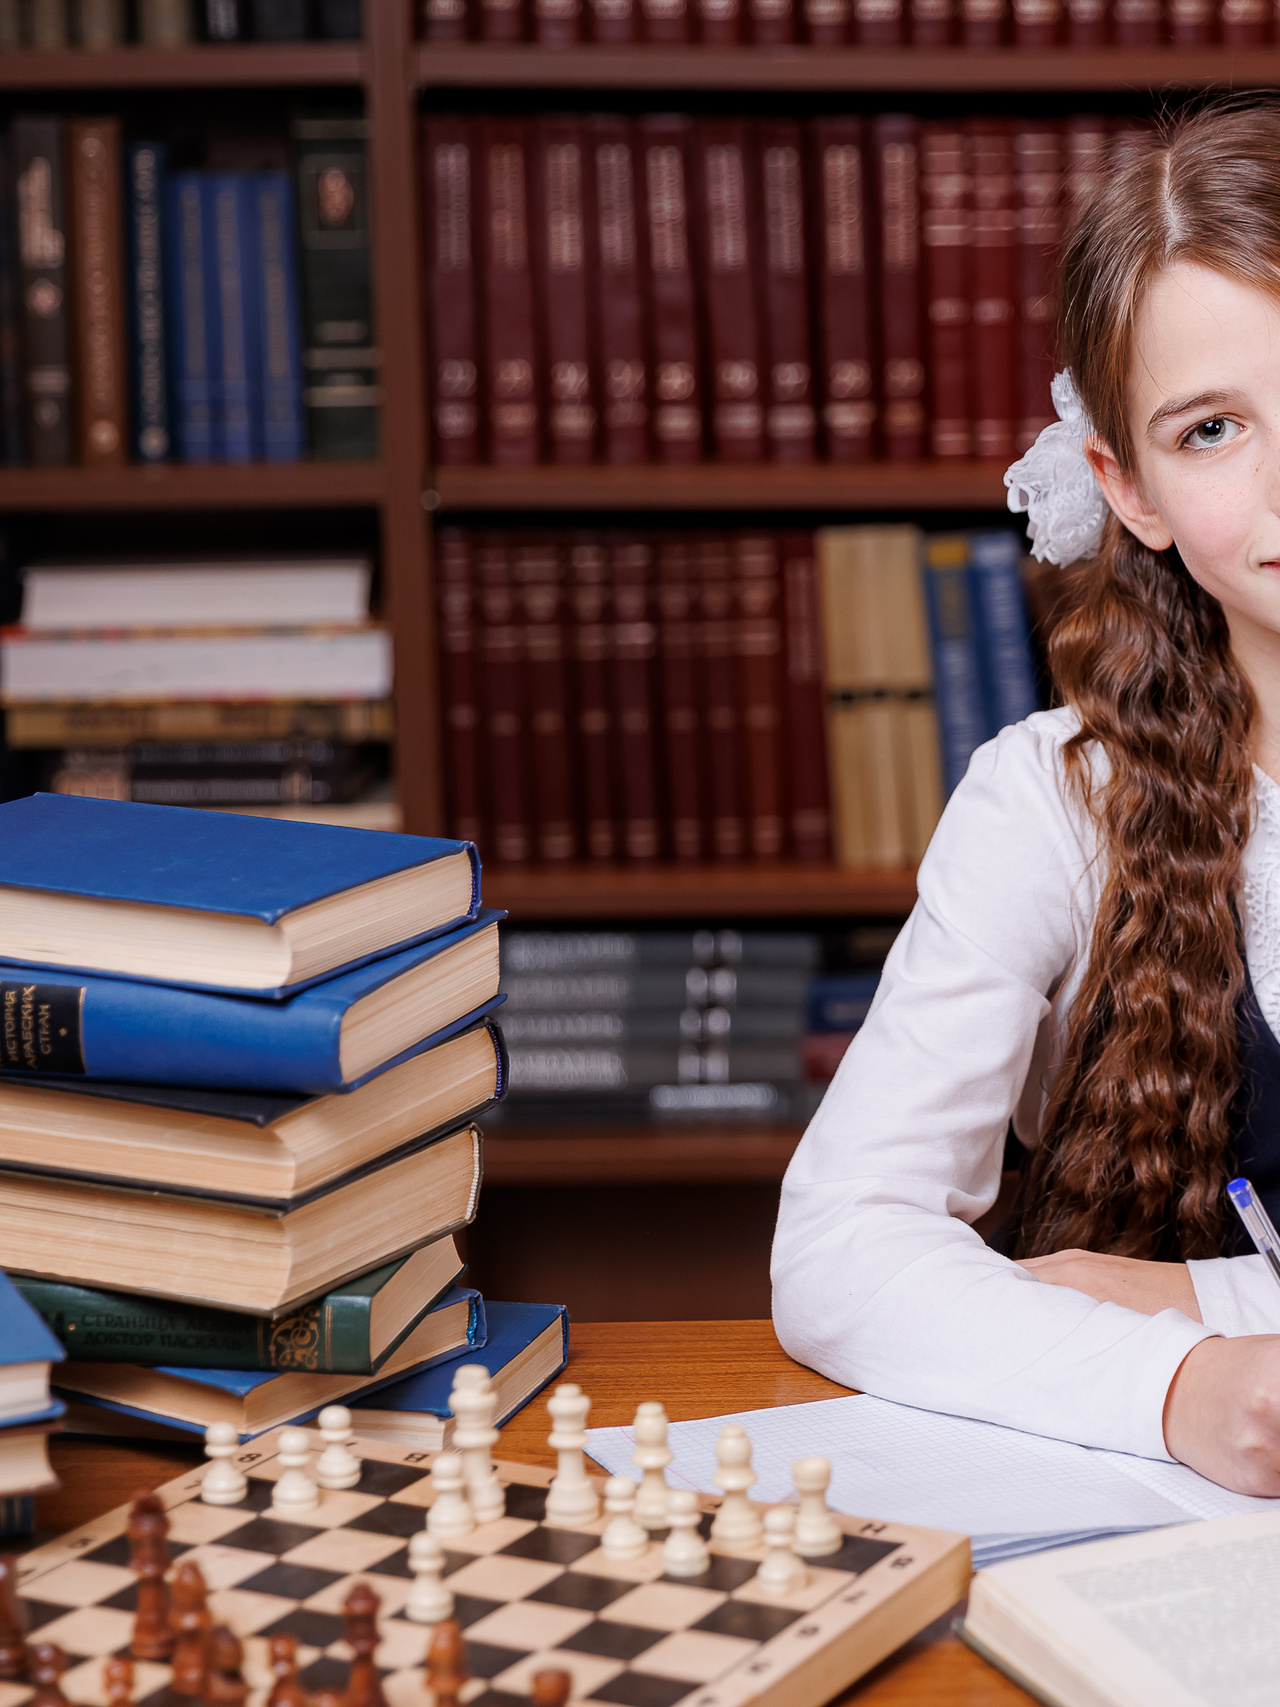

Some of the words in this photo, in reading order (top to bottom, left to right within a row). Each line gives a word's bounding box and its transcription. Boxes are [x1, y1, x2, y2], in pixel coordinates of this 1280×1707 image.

[5, 990, 18, 1061] ИСТОРИЯ
[21, 984, 38, 1070] АРАБСКИХ
[38, 1004, 52, 1055] СТРАН
[81, 1313, 176, 1333] СТРАНИЦА
[83, 1331, 154, 1348] ДОКТОР
